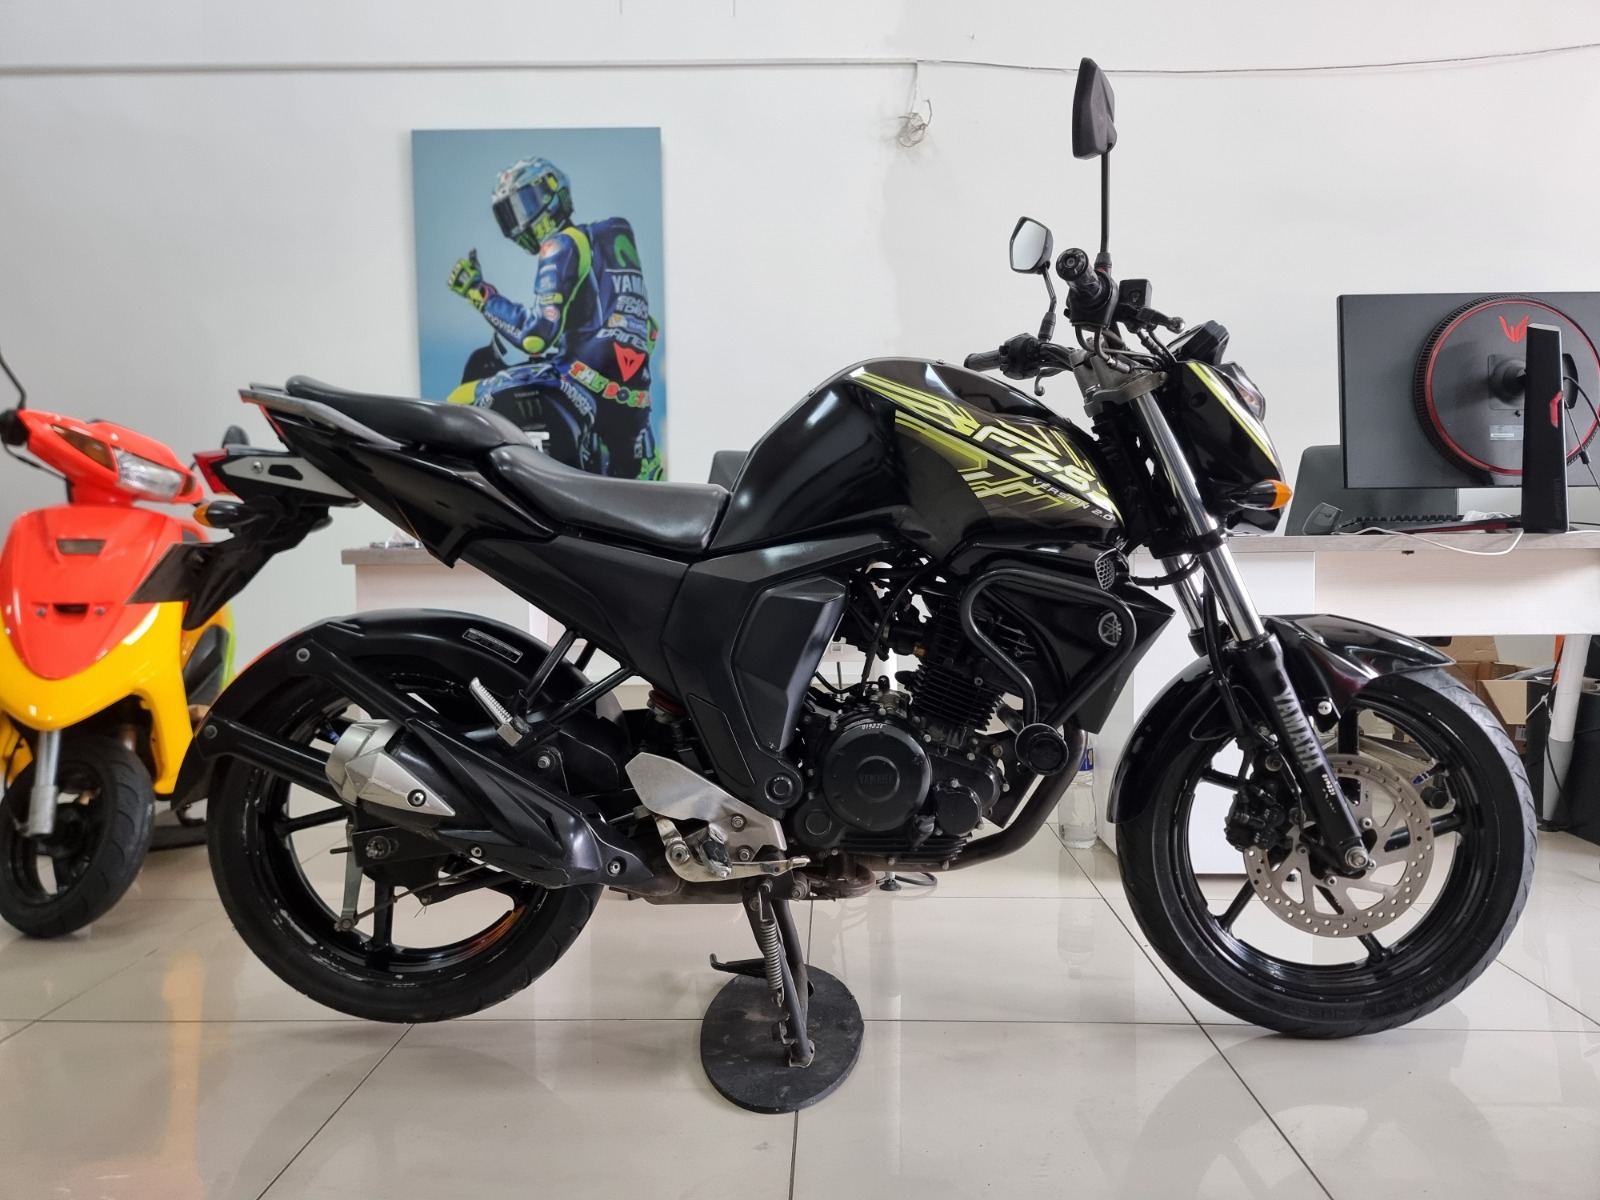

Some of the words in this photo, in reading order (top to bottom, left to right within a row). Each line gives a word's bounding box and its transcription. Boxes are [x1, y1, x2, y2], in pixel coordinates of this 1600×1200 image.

[569, 360, 610, 393] THE
[1032, 478, 1090, 510] VERSION
[1091, 508, 1116, 521] 2.0
[1273, 685, 1324, 773] YAMAHA
